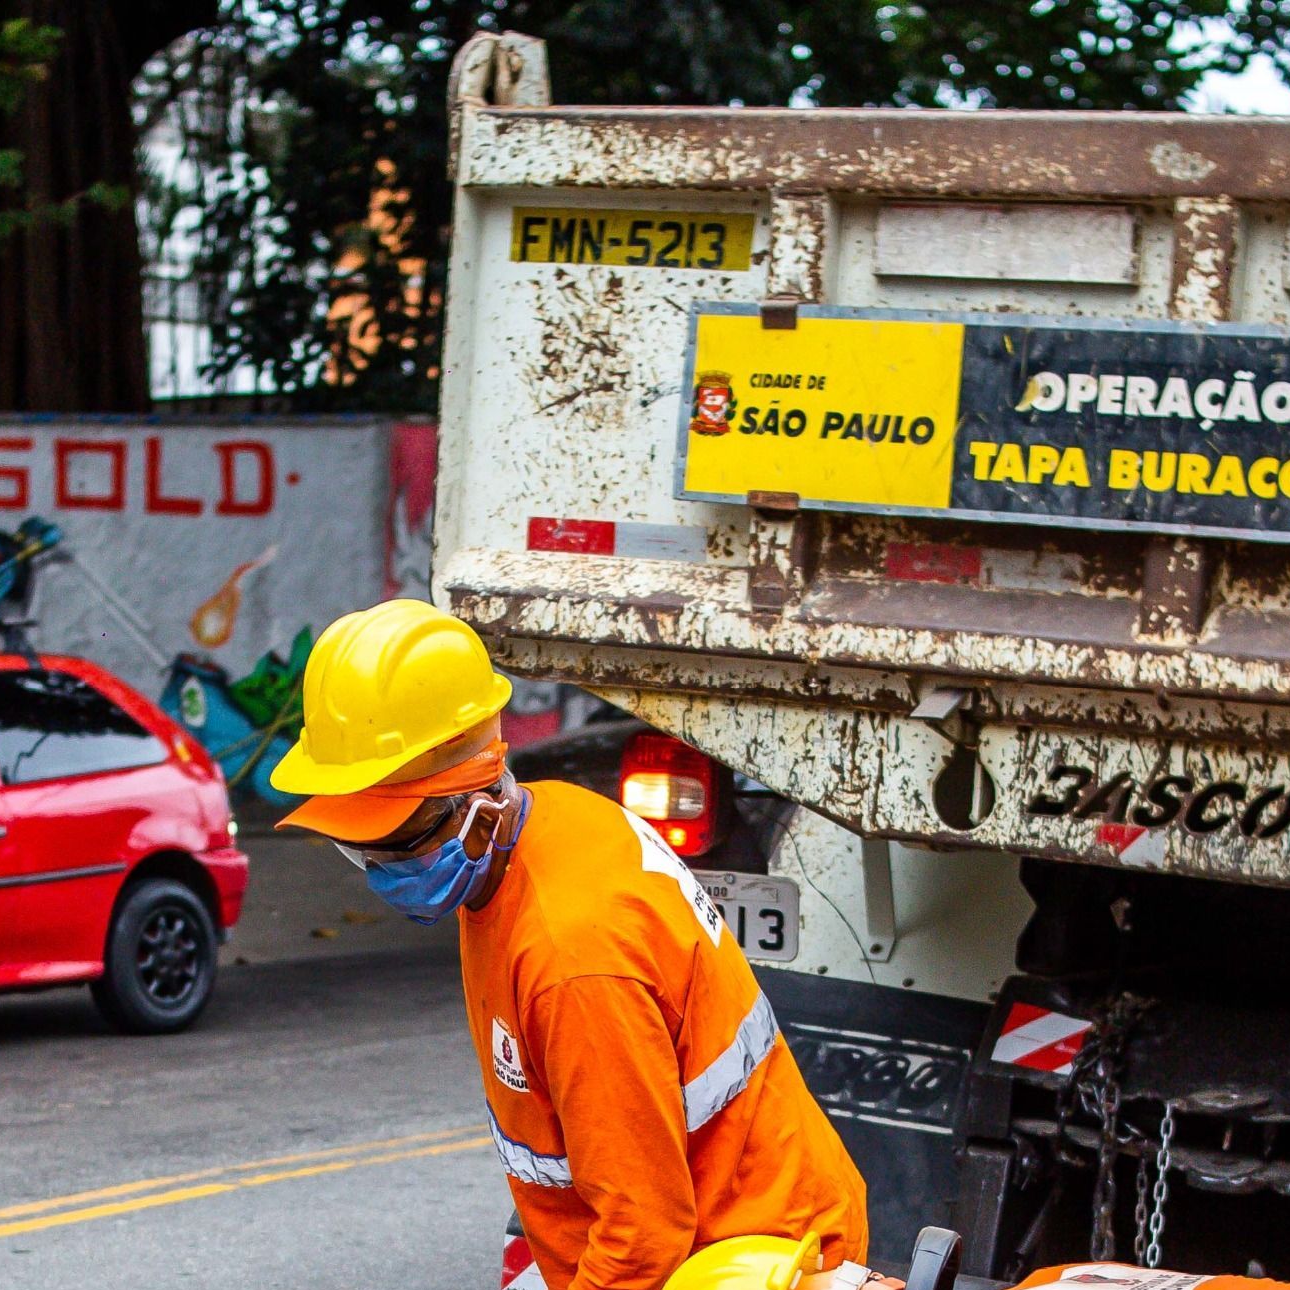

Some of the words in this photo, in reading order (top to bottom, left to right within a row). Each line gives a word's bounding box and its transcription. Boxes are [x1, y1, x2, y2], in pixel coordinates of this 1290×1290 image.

[519, 216, 727, 269] FMN-5213
[749, 373, 802, 389] CIDADE
[807, 375, 826, 390] DE
[738, 400, 808, 437] SÃO
[819, 411, 936, 446] PAULO
[969, 441, 1092, 488] TAPA
